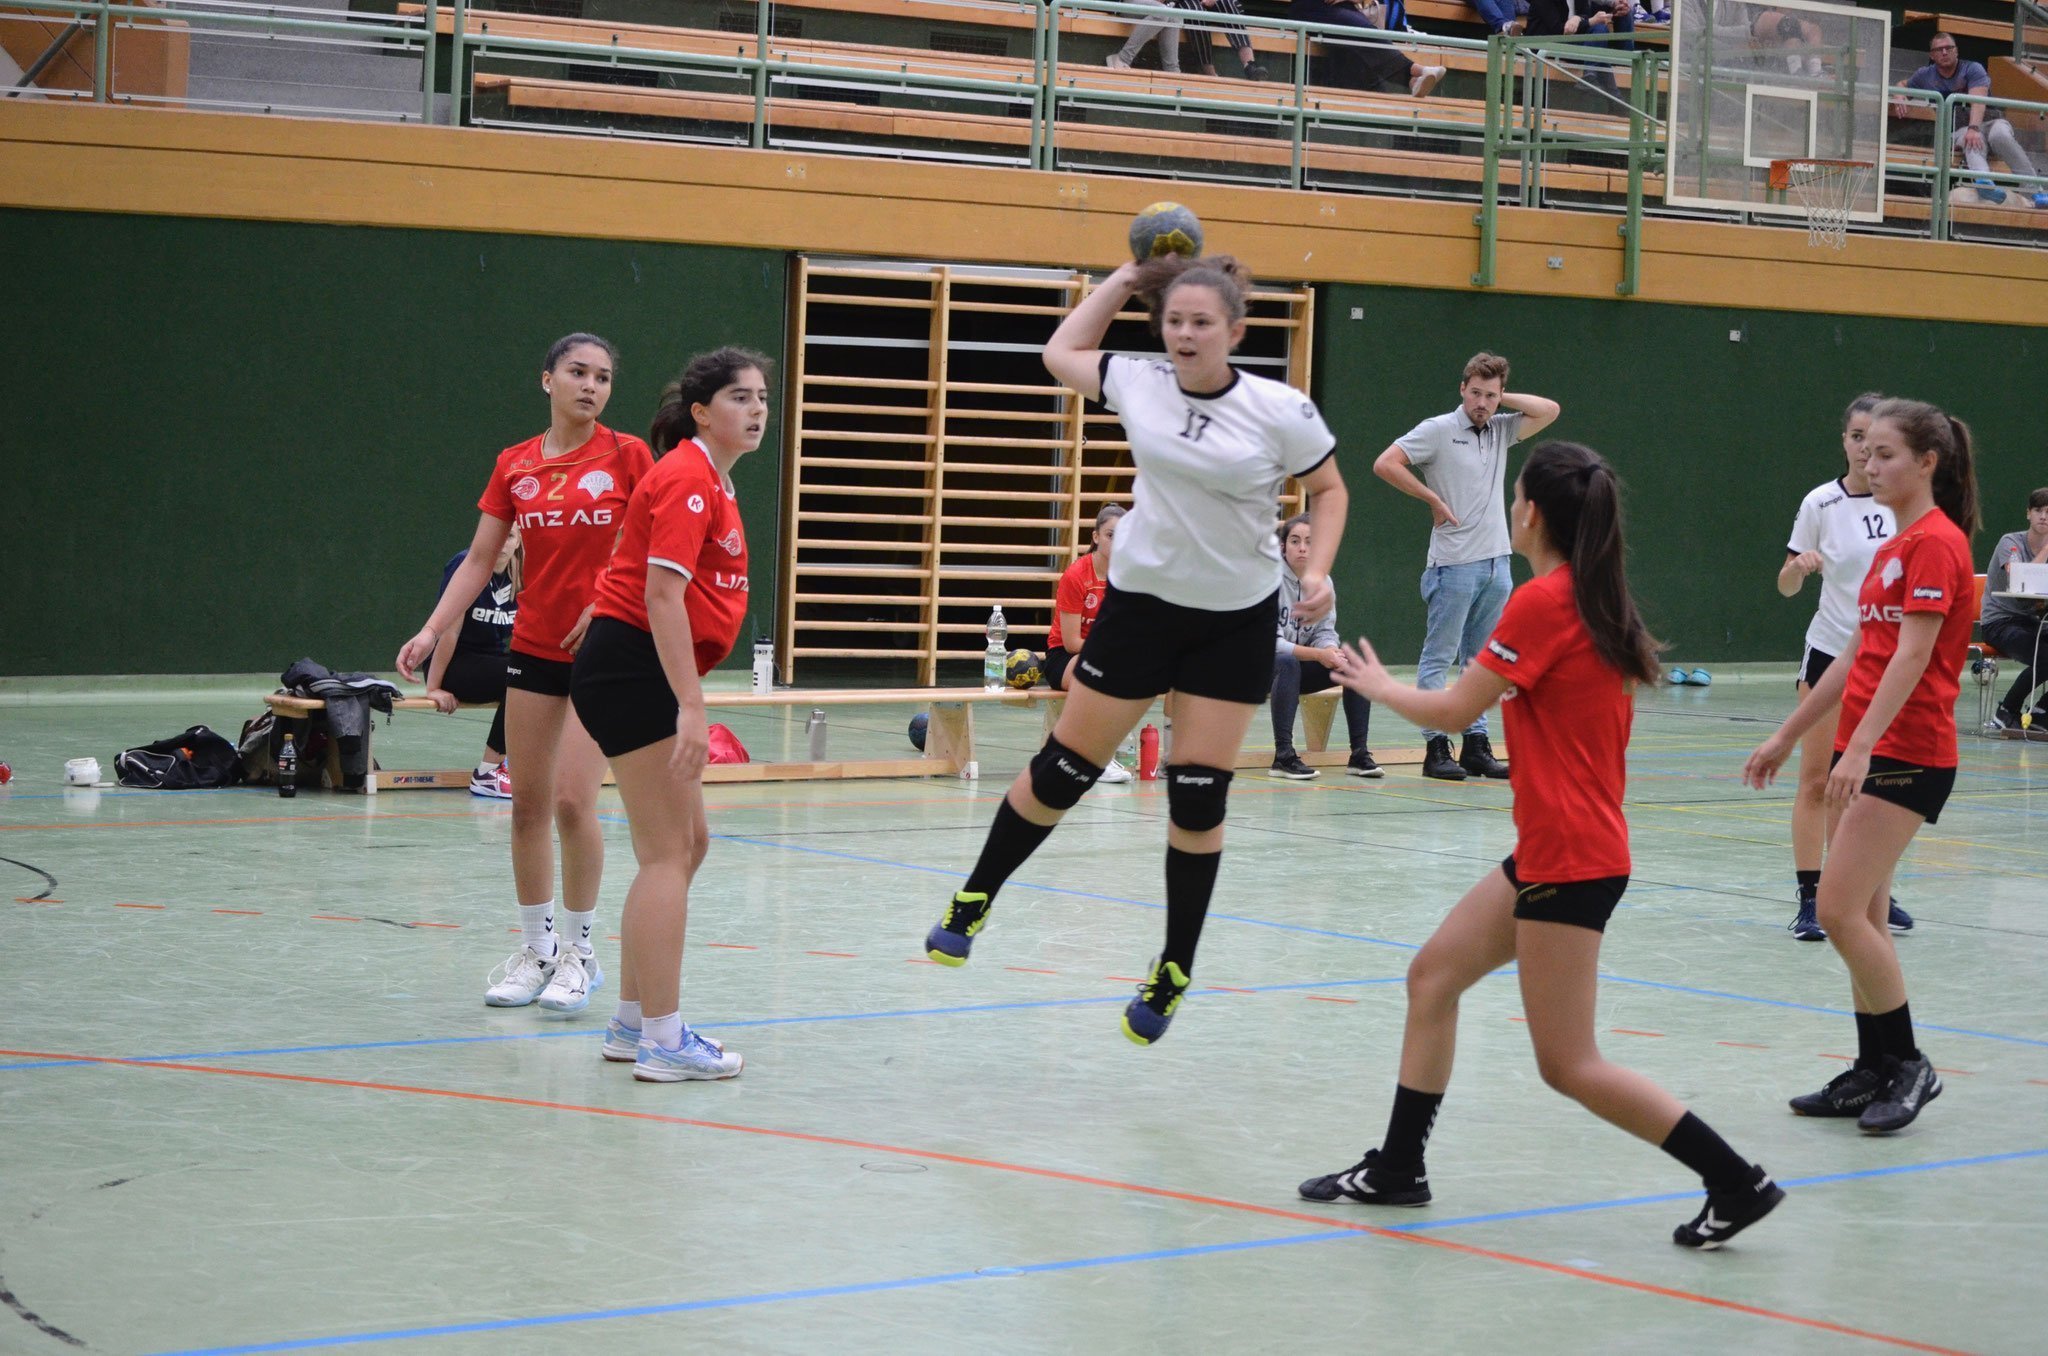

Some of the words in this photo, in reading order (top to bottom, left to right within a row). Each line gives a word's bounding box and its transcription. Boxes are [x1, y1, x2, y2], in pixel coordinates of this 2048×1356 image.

[1178, 408, 1213, 442] 17
[547, 472, 568, 501] 2
[1818, 495, 1843, 510] Kempa
[570, 509, 612, 526] AG
[1862, 514, 1888, 540] 12
[1913, 587, 1943, 600] Kempa
[1488, 639, 1518, 663] Kempa
[1081, 660, 1104, 677] Kempa
[1176, 774, 1214, 787] Kempa
[1875, 777, 1913, 787] Kempa
